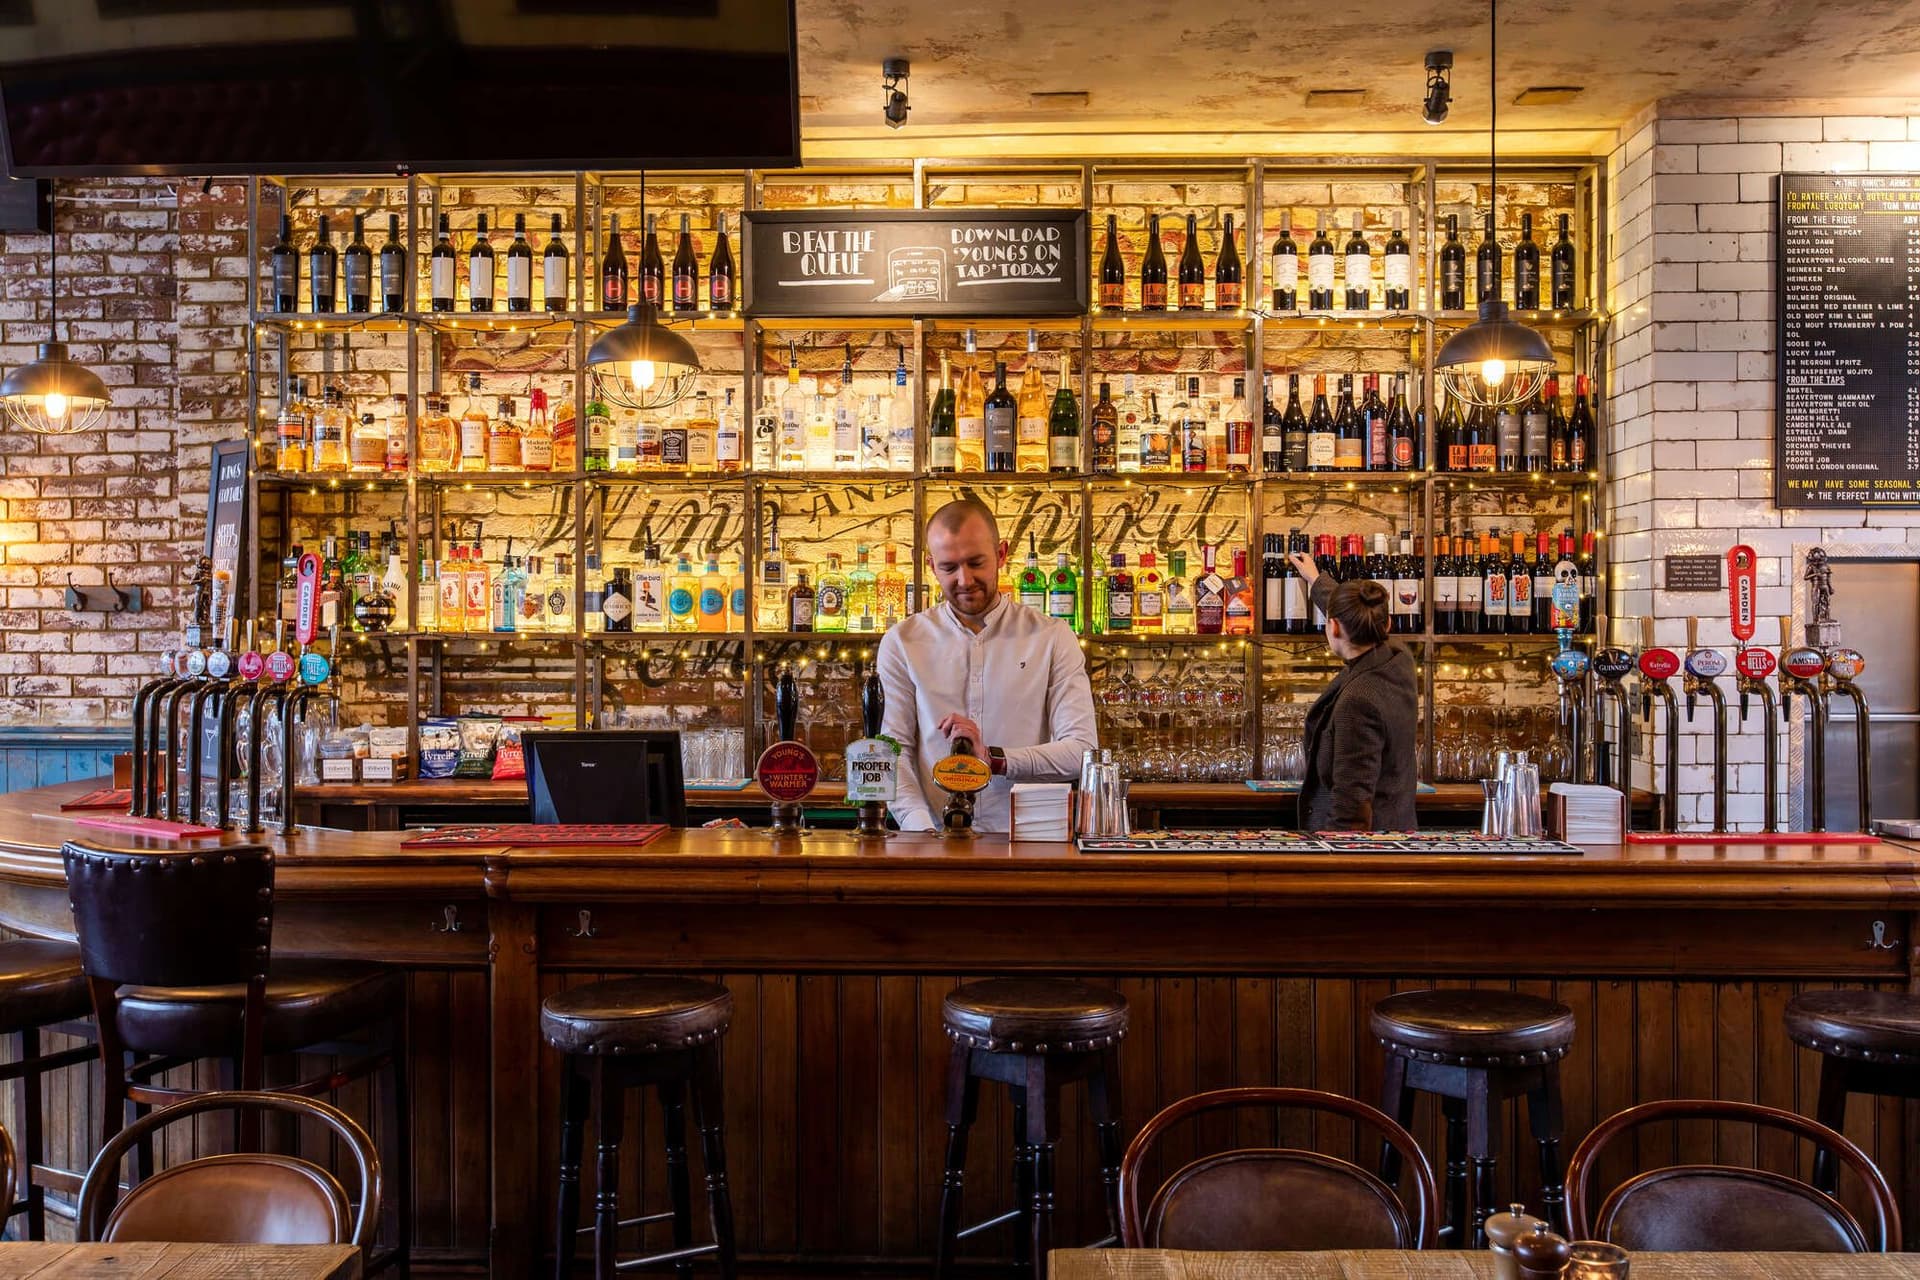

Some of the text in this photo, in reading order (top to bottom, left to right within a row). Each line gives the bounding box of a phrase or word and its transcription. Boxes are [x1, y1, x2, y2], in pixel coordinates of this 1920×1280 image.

[1787, 192, 1797, 201] I'D
[1801, 192, 1830, 201] RATHER
[1835, 192, 1852, 201] HAVE
[1857, 192, 1862, 201] A
[1866, 192, 1894, 201] BOTTLE
[1787, 202, 1820, 210] FRONTAL
[1824, 202, 1865, 210] LOBOTOMY
[1883, 202, 1899, 210] TOM
[1787, 215, 1918, 224] FROM THE FRIDGE ABV
[951, 227, 1060, 245] DOWNLOAD
[783, 230, 876, 254] BEAT THE
[1037, 243, 1061, 262] ON
[801, 253, 864, 276] QUEUE
[998, 262, 1058, 278] TODAY
[1786, 376, 1846, 384] FROM THE TAPS
[1787, 480, 1800, 488] WE
[1802, 480, 1818, 488] MAY
[1825, 480, 1844, 488] HAVE
[1849, 480, 1869, 488] SOME
[1874, 480, 1911, 488] SEASONAL
[1818, 491, 1920, 500] THE PERFECT MATCH WITH
[302, 585, 310, 626] CAMDEN
[851, 761, 891, 772] PROPER
[862, 773, 882, 785] JOB
